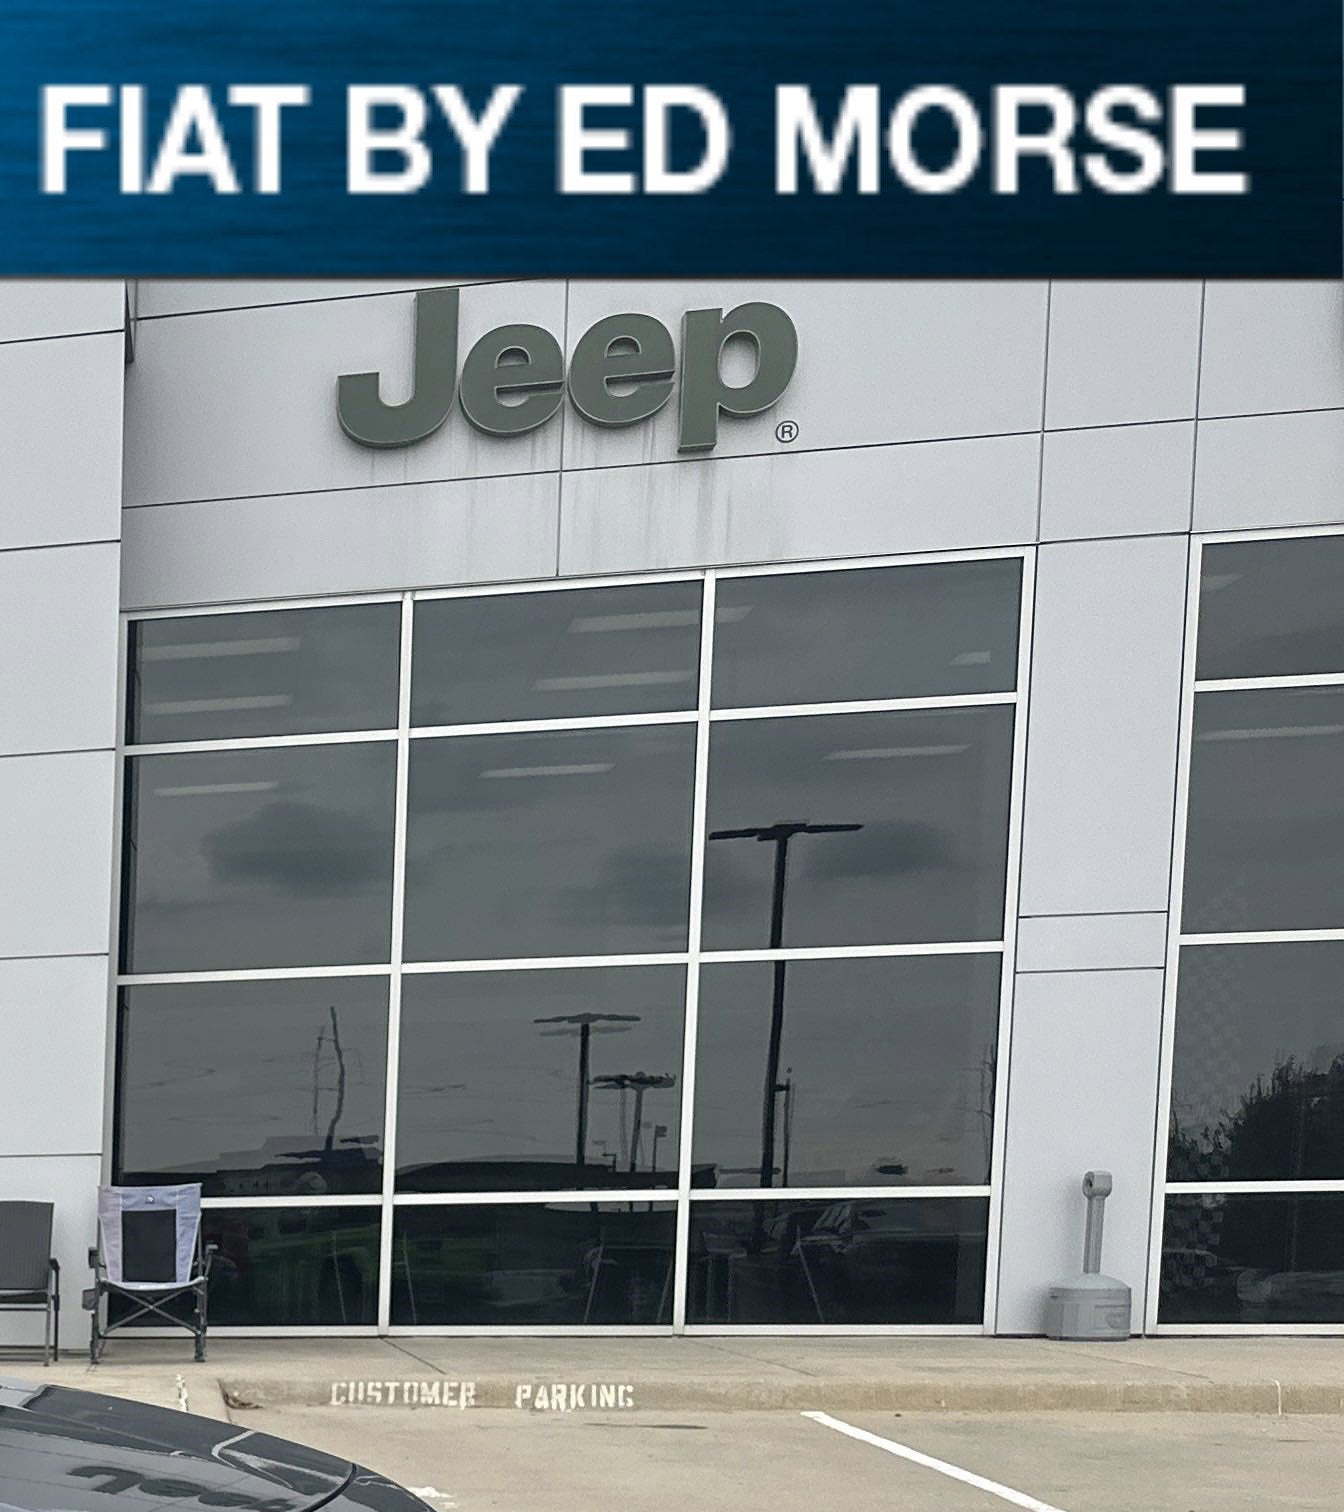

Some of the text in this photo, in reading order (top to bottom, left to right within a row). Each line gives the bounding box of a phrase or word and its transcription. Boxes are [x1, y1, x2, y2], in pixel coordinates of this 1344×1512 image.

[337, 287, 800, 453] Jeep
[330, 1381, 635, 1412] CUSTOMER PARKING
